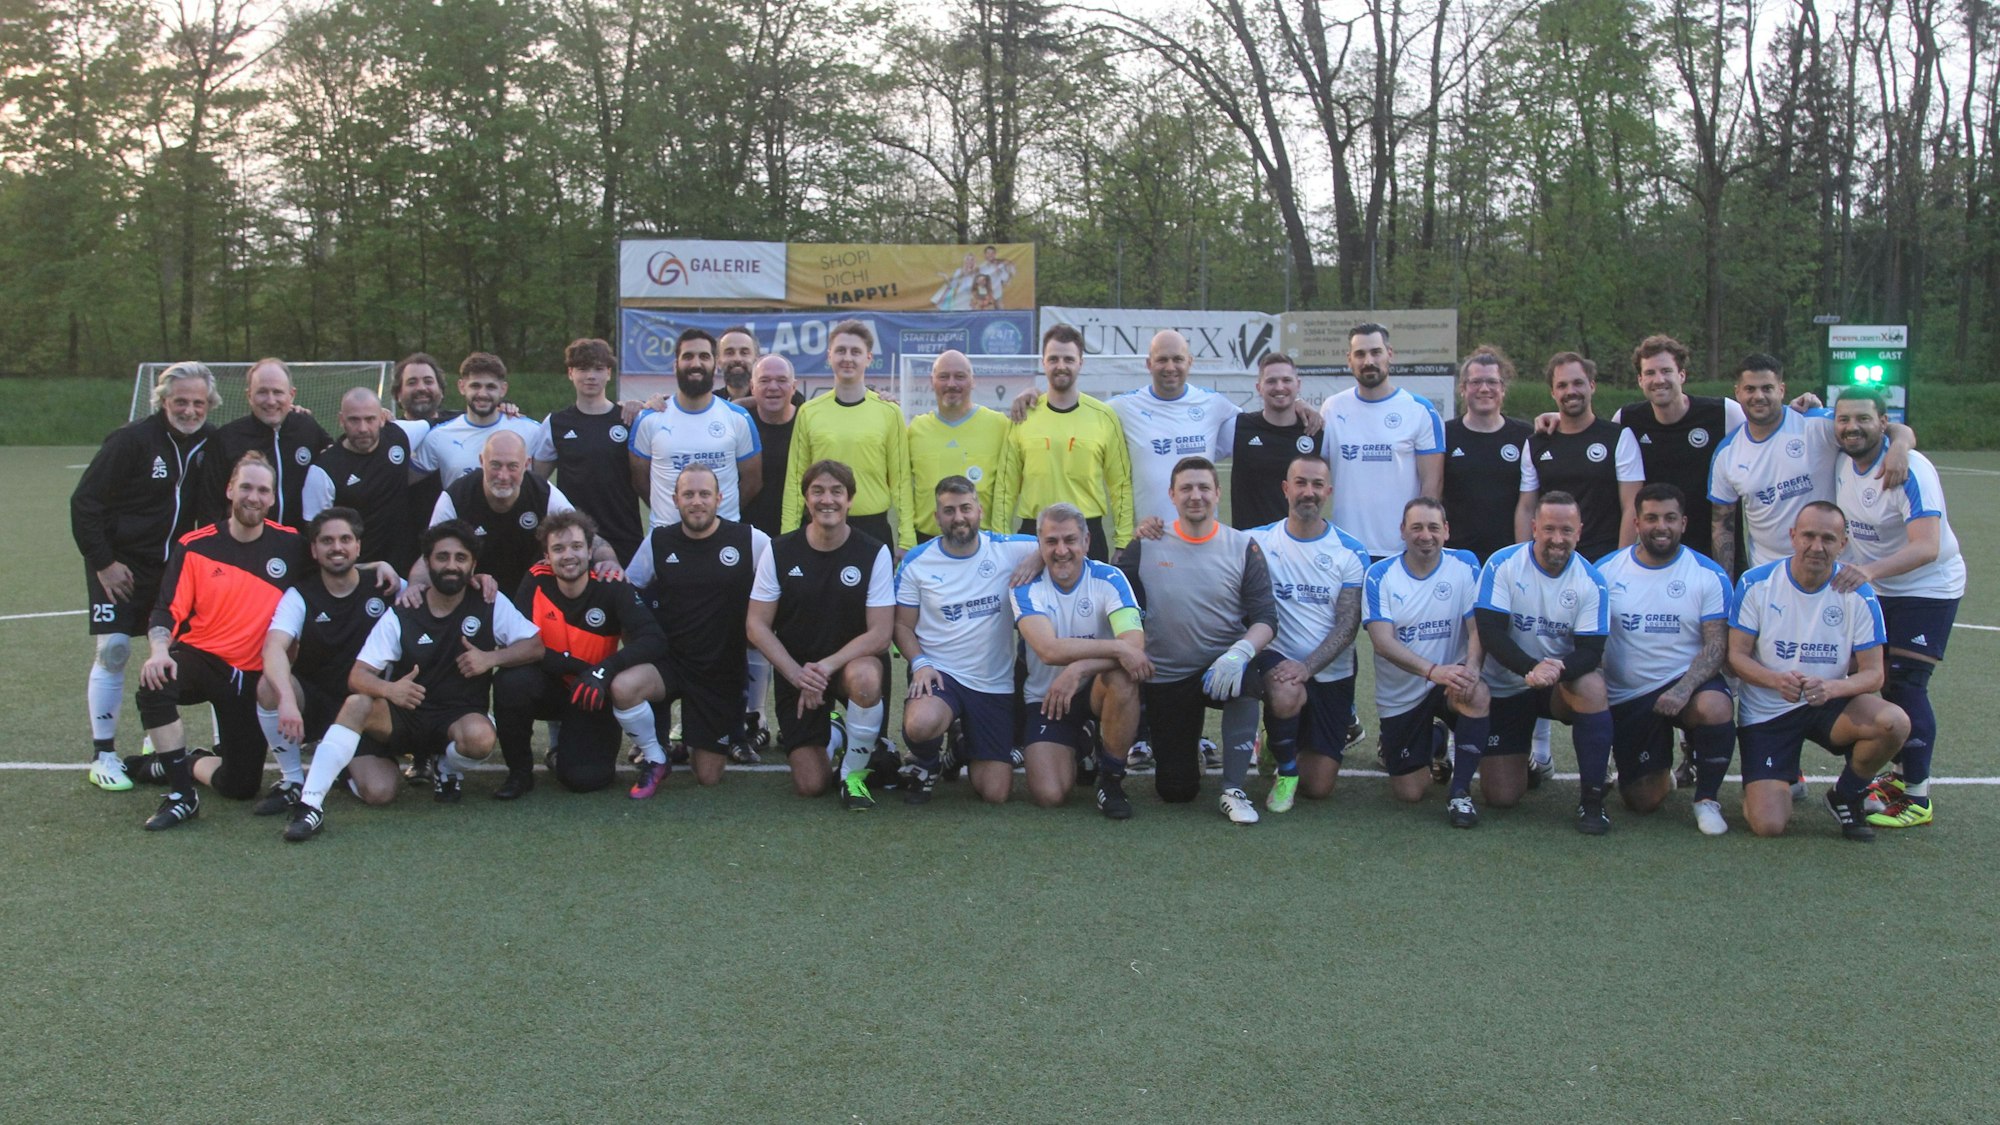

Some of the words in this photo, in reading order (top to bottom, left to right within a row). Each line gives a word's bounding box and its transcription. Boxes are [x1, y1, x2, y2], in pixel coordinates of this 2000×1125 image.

[690, 258, 761, 273] GALERIE
[826, 282, 898, 305] HAPPY!
[744, 319, 883, 356] LAOA
[902, 332, 938, 342] STARTE
[1832, 351, 1857, 360] HEIM
[1878, 351, 1903, 360] GAST
[1175, 435, 1206, 444] GREEK
[694, 452, 726, 460] GREEK
[152, 466, 168, 479] 25
[1776, 474, 1811, 490] GREEK
[1296, 584, 1331, 594] GREEK
[966, 594, 1001, 608] GREEK
[93, 603, 115, 622] 25
[1645, 613, 1680, 622] GREEK
[1418, 619, 1452, 630] GREEK
[1800, 643, 1838, 652] GREEK
[1040, 724, 1047, 735] 7
[1765, 756, 1773, 768] 4
